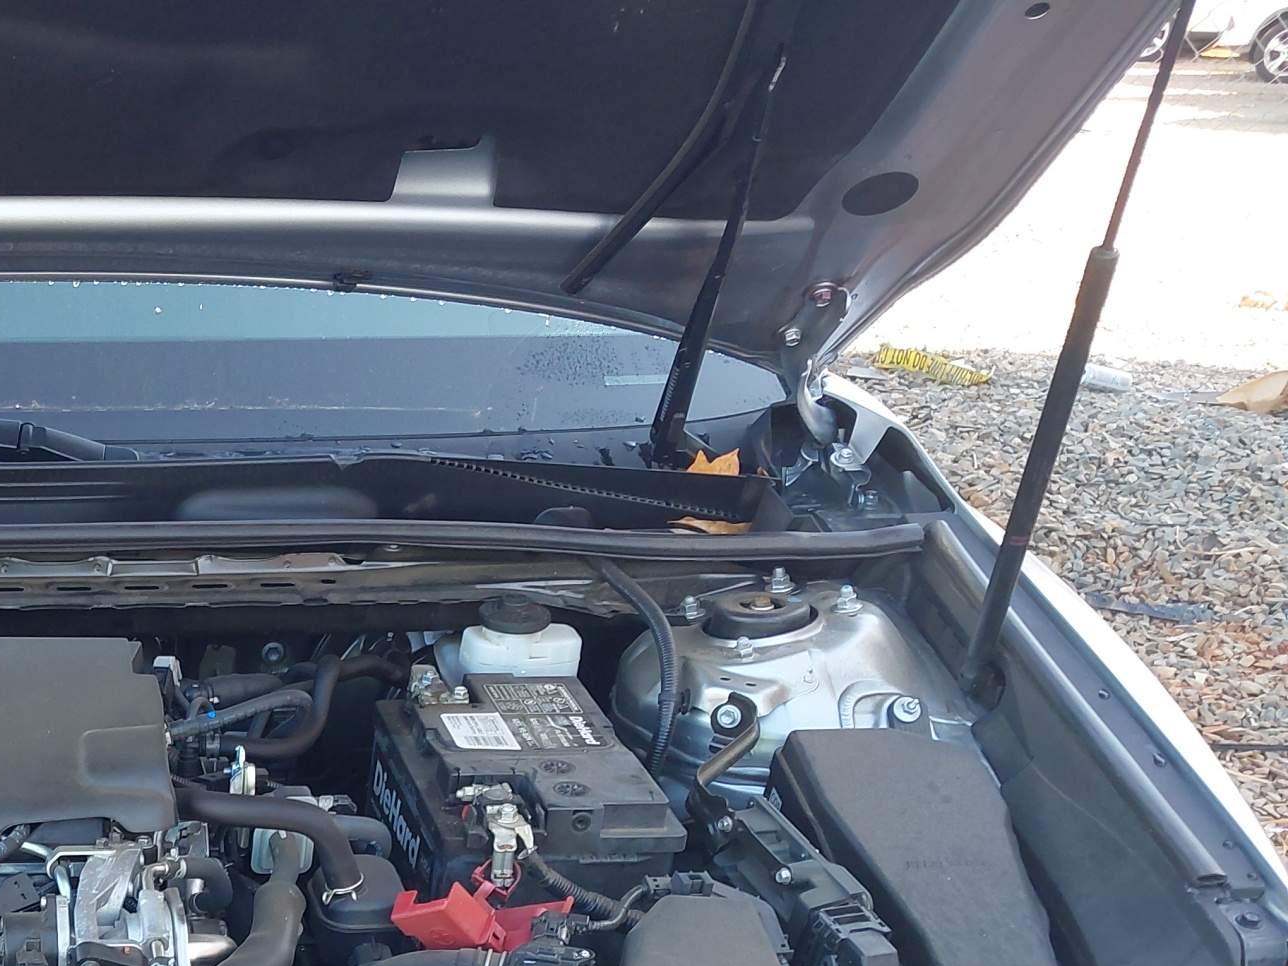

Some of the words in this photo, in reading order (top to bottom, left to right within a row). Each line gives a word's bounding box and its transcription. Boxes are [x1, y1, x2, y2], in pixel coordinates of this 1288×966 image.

[889, 349, 912, 365] NOT
[912, 352, 927, 370] DO
[568, 716, 601, 745] DieHard
[373, 759, 420, 869] DieHard
